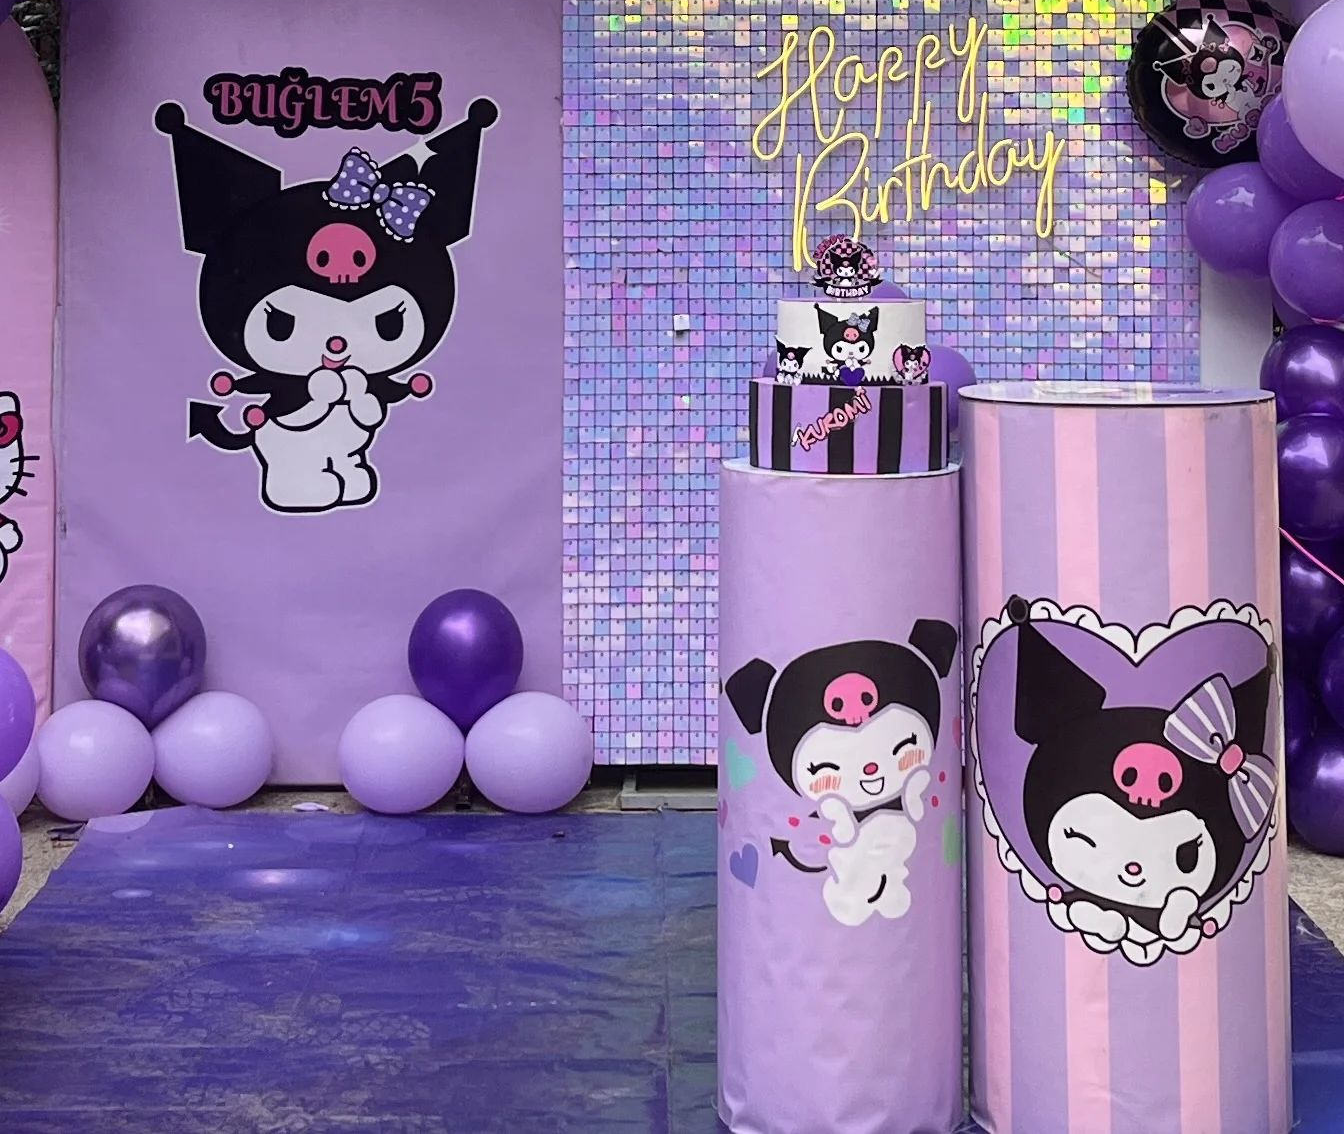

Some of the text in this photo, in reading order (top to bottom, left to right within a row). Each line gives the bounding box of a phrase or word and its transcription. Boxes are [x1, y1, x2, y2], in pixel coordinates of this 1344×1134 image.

[210, 75, 437, 130] BUĞLEM 5
[753, 17, 988, 160] Happy
[793, 92, 1065, 272] Birthday
[825, 284, 869, 298] BIRTHDAY
[796, 386, 873, 453] KUROMI
